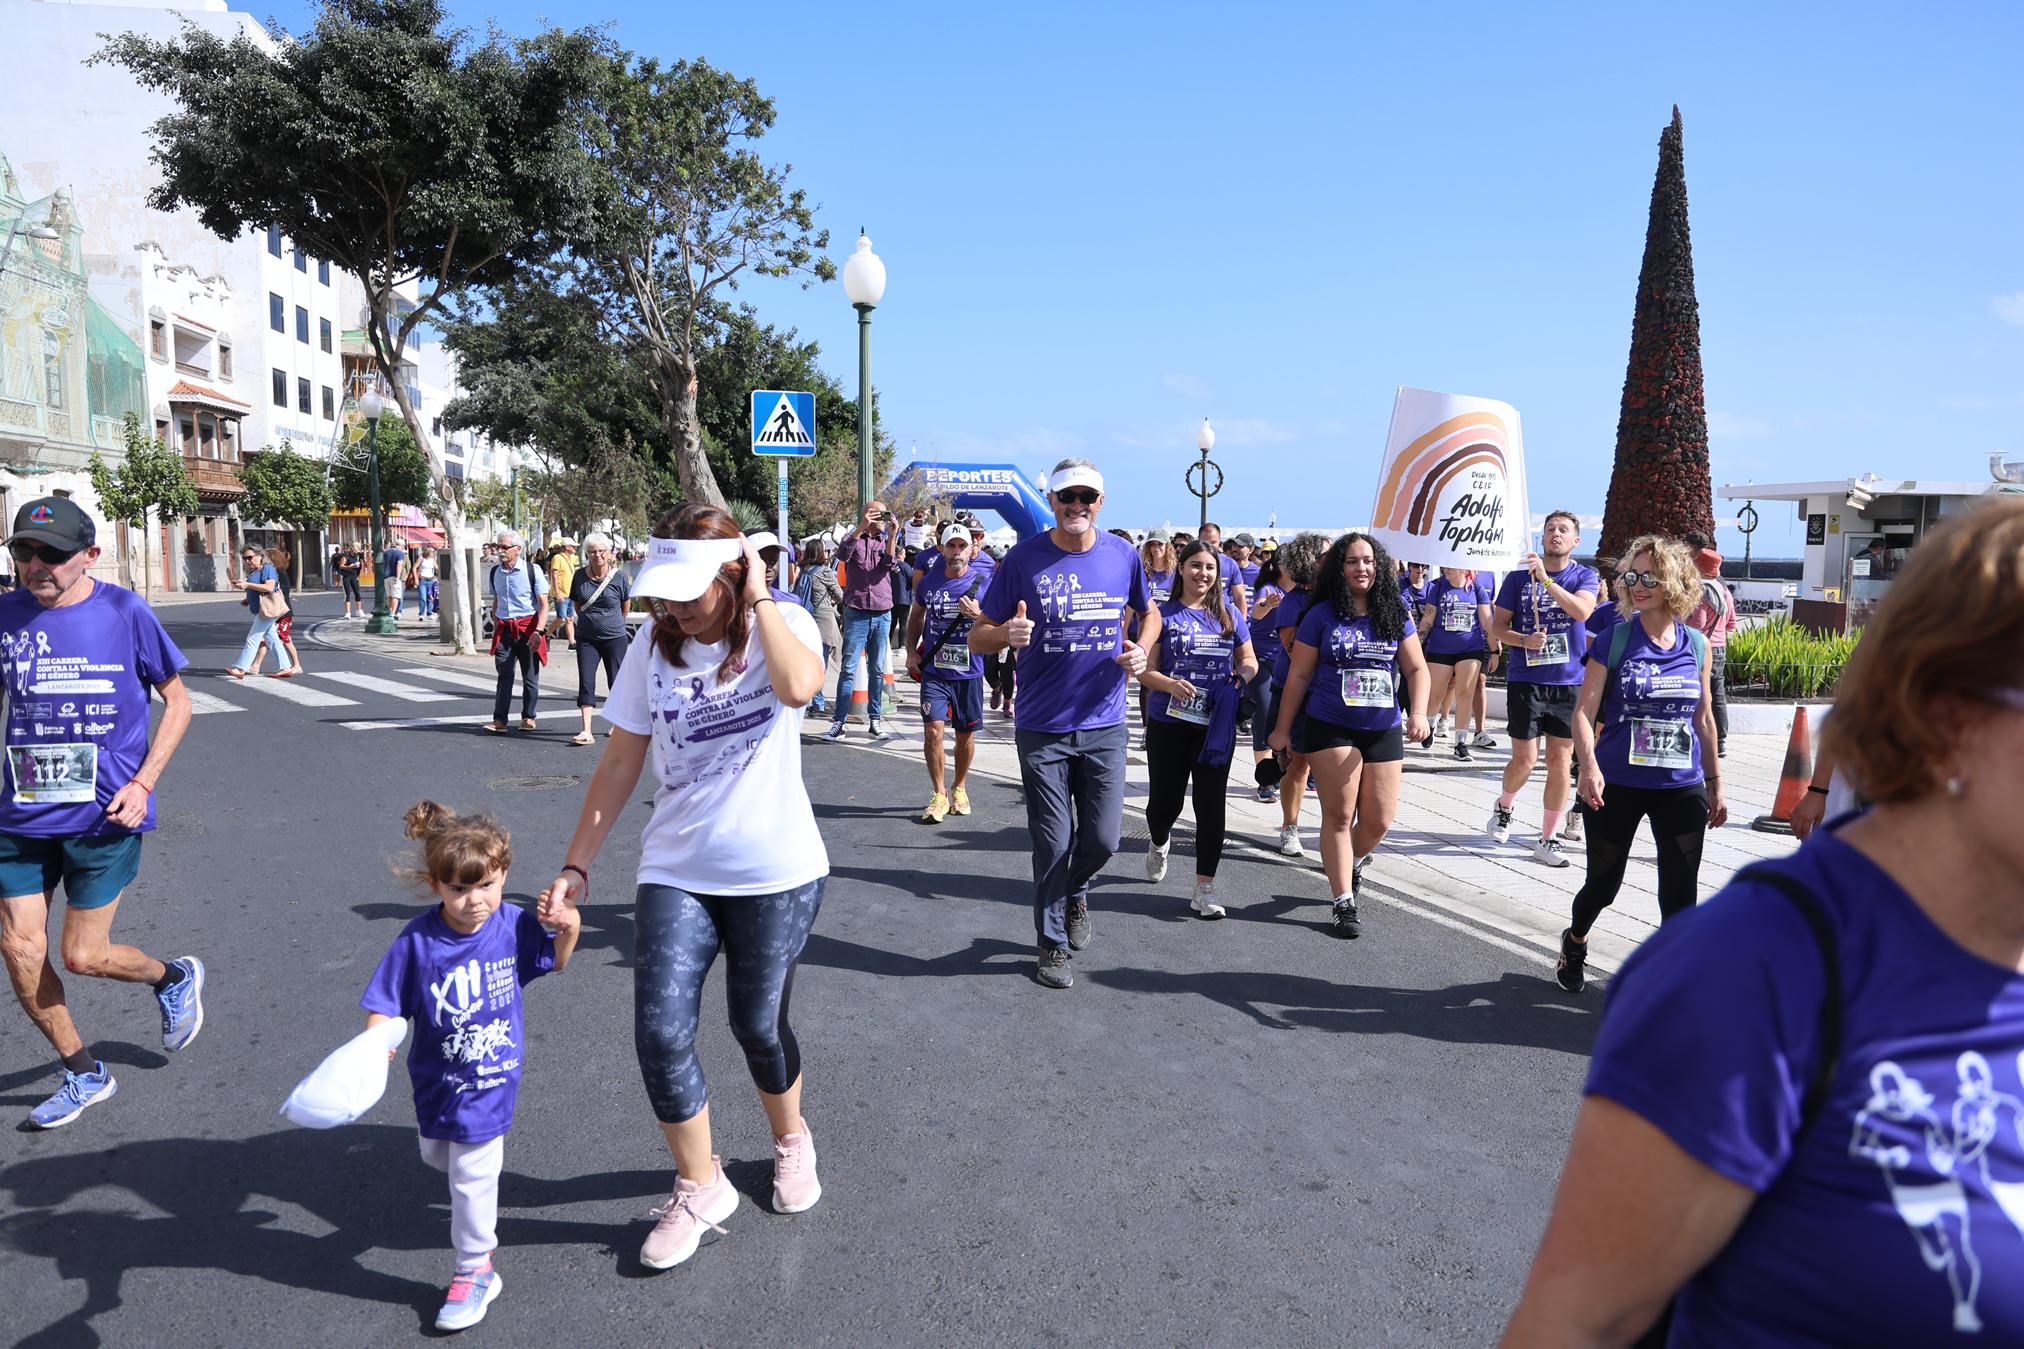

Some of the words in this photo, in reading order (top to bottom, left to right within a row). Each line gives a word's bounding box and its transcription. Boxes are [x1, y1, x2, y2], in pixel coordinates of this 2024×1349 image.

[926, 470, 1012, 483] DEPORTES
[51, 657, 88, 665] CARRERA
[943, 651, 960, 662] 016
[36, 665, 68, 673] CONTRA
[69, 664, 80, 672] LA
[80, 664, 125, 672] VIOLENCIA
[36, 672, 47, 680] DE
[48, 671, 80, 680] GÉNERO
[1357, 682, 1380, 694] 112
[685, 703, 720, 720] CONTRA
[721, 700, 734, 710] LA
[733, 684, 774, 705] VIOLENCI
[85, 704, 100, 715] ICI
[687, 718, 700, 728] DE
[701, 709, 736, 724] GÉNERO
[705, 720, 746, 737] LANZAROTE
[1647, 735, 1675, 751] 112
[33, 762, 71, 782] 112
